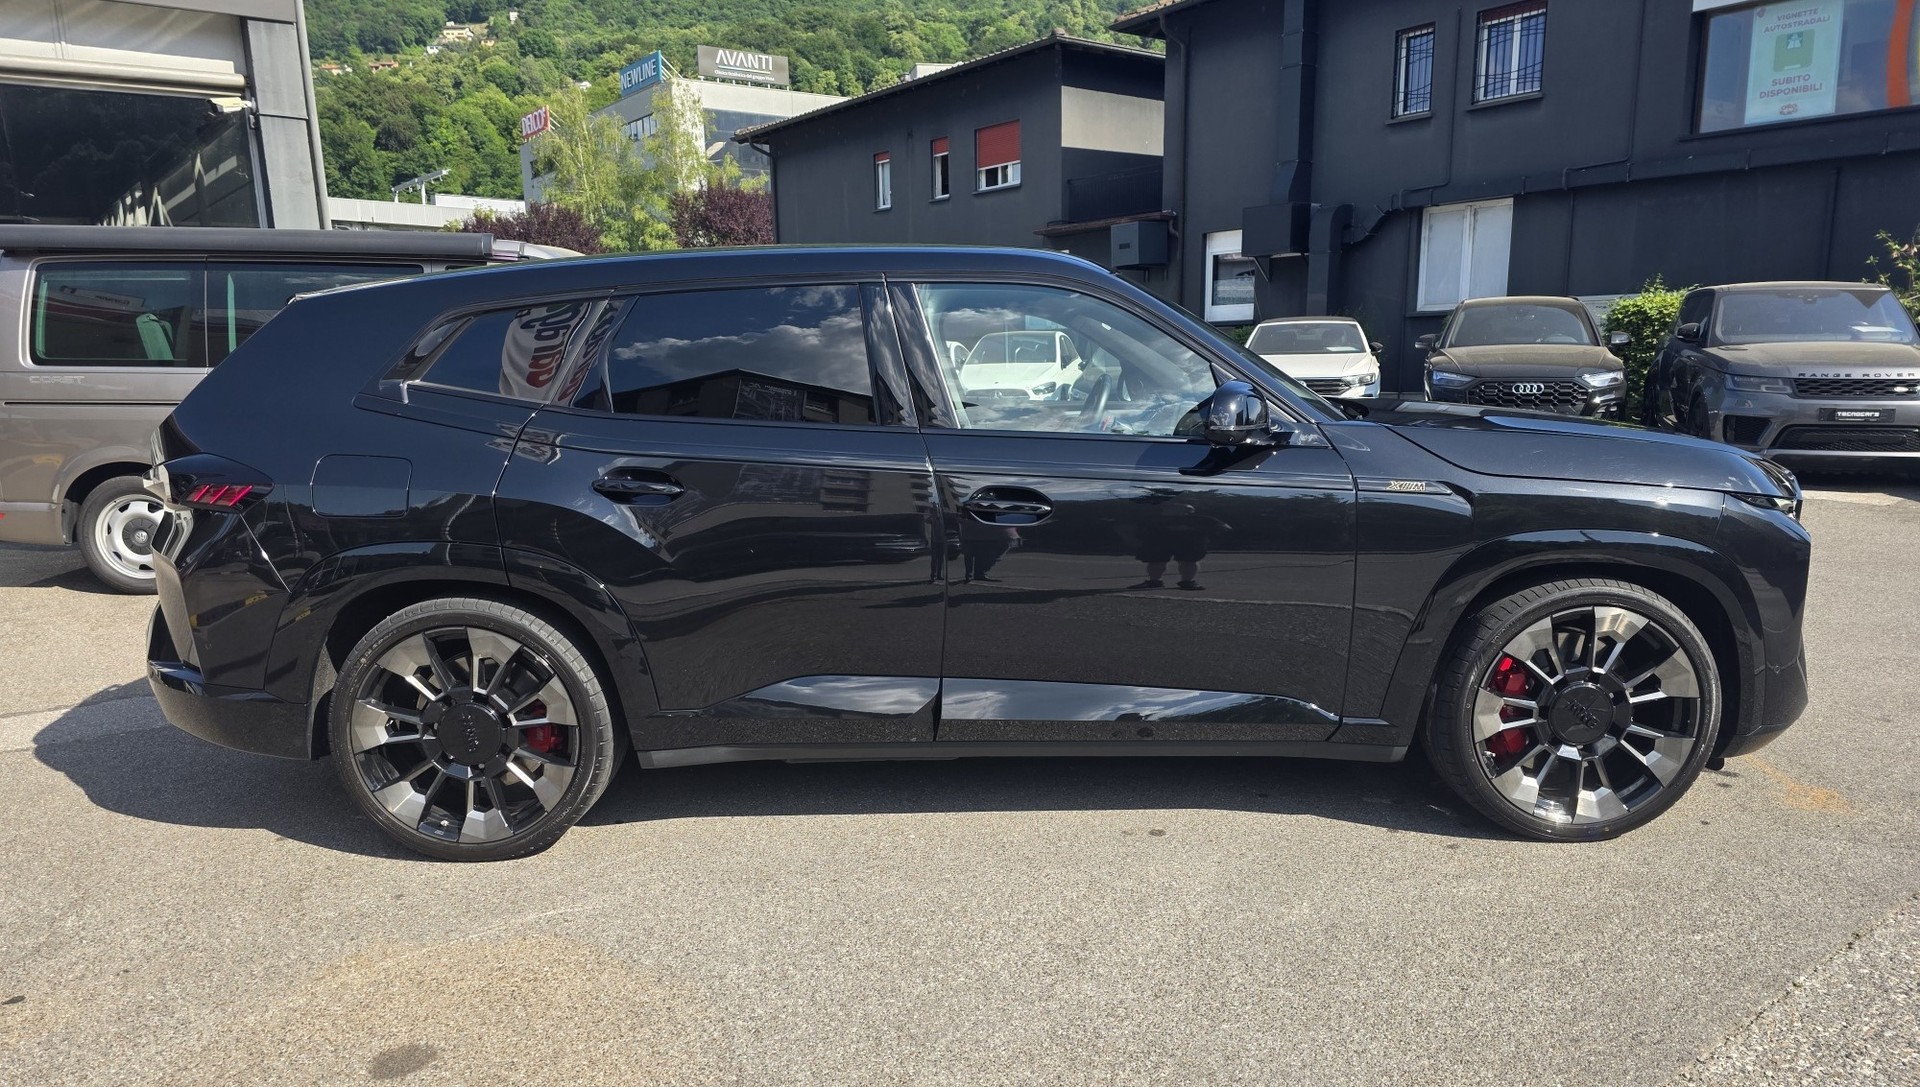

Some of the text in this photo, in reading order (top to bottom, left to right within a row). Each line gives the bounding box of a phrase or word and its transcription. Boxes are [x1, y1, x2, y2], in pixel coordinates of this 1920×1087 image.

[1777, 7, 1819, 21] VIGNETTE
[1763, 15, 1831, 33] AUTOSTRADALI
[715, 49, 773, 71] AVANTI
[620, 58, 657, 90] NEWLINE
[1771, 73, 1811, 87] SUBITO
[1759, 83, 1823, 99] DISPONIBILI
